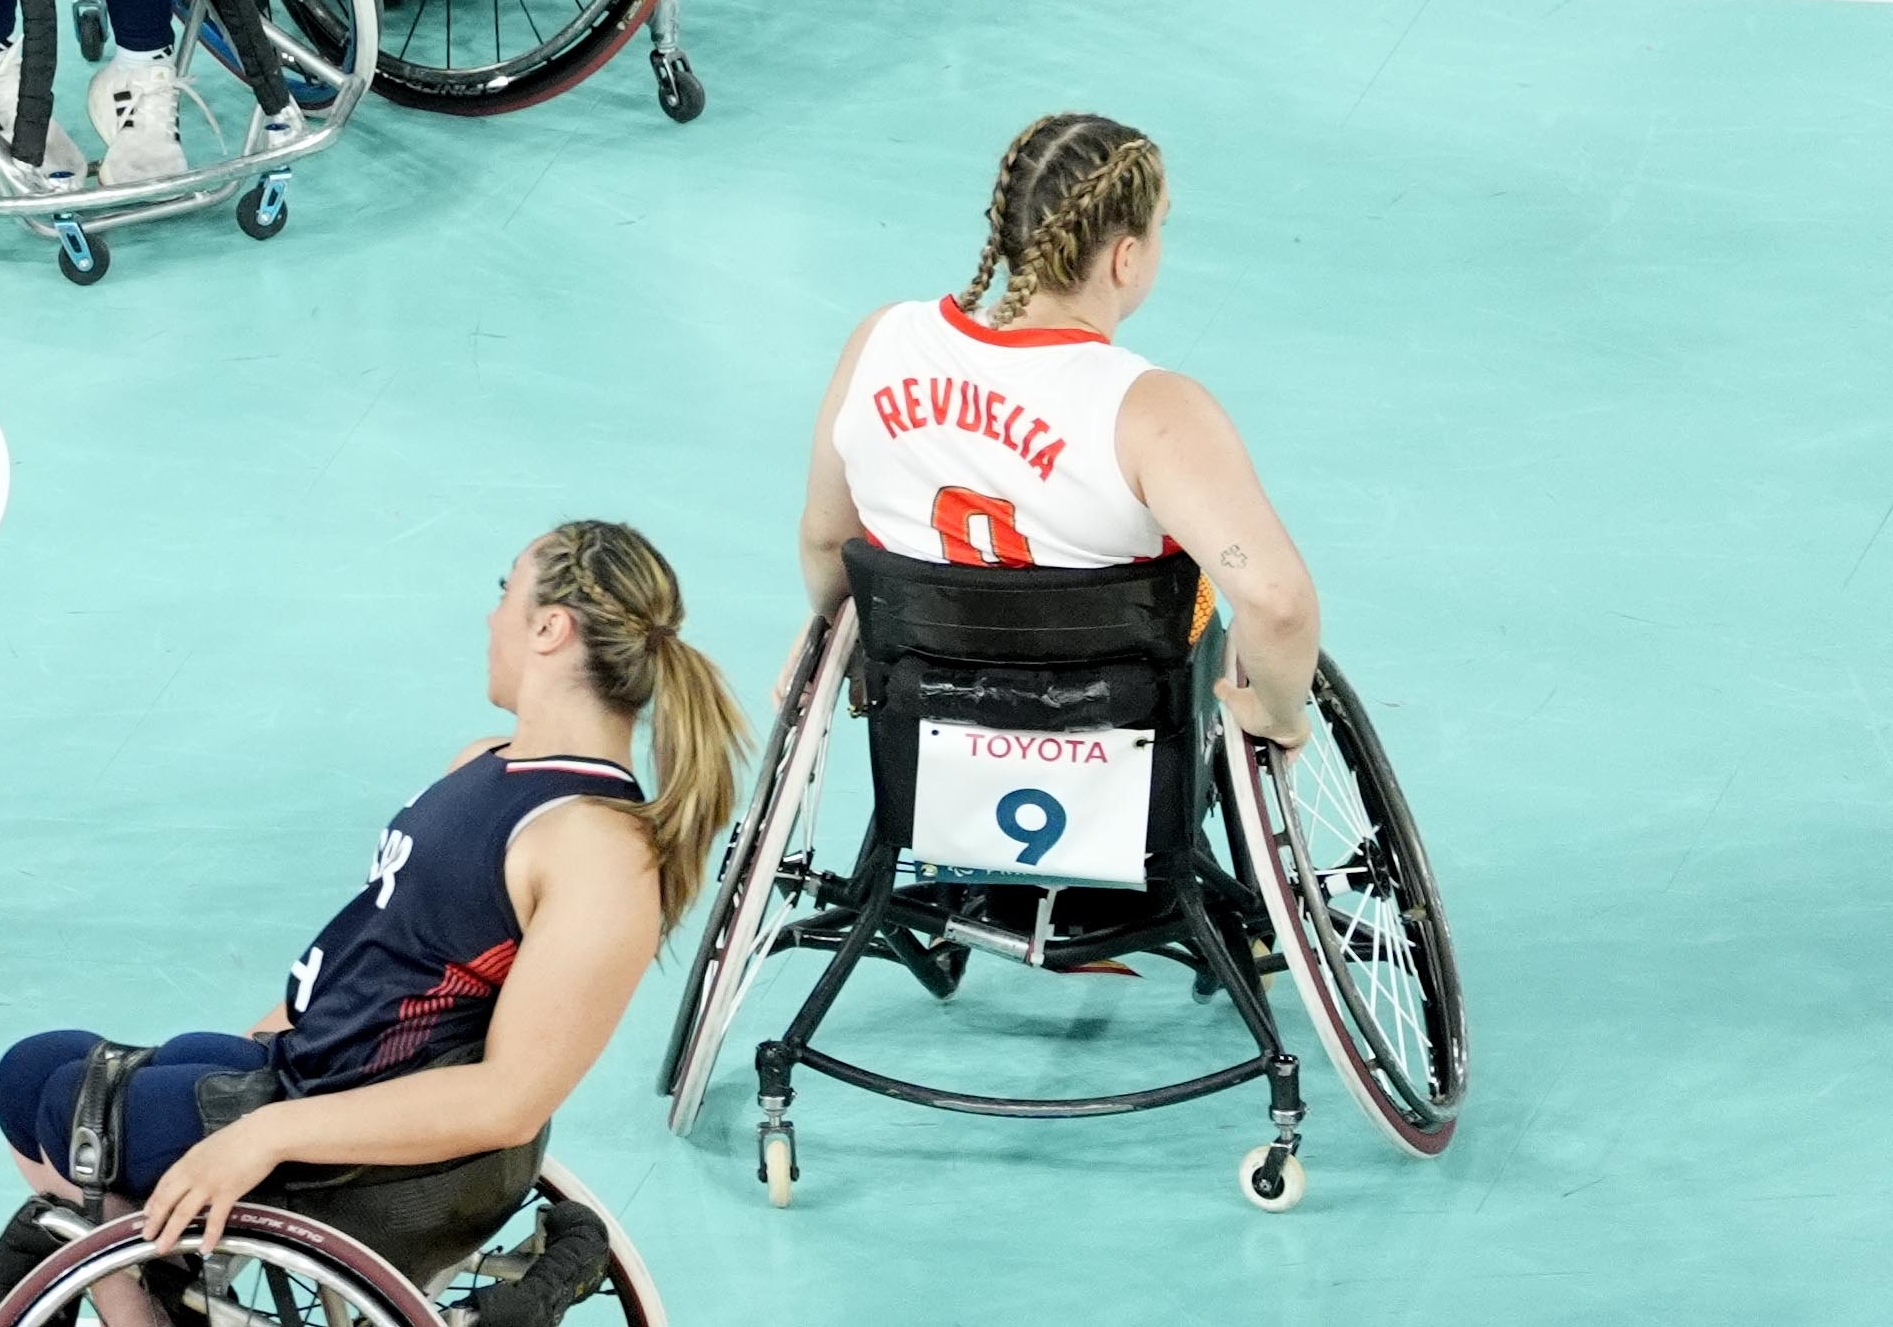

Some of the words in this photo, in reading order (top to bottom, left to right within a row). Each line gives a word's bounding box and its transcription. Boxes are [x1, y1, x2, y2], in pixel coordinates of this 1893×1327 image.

[874, 377, 1066, 481] REVUELTA
[965, 733, 1108, 763] TOYOTA
[996, 788, 1066, 866] 9
